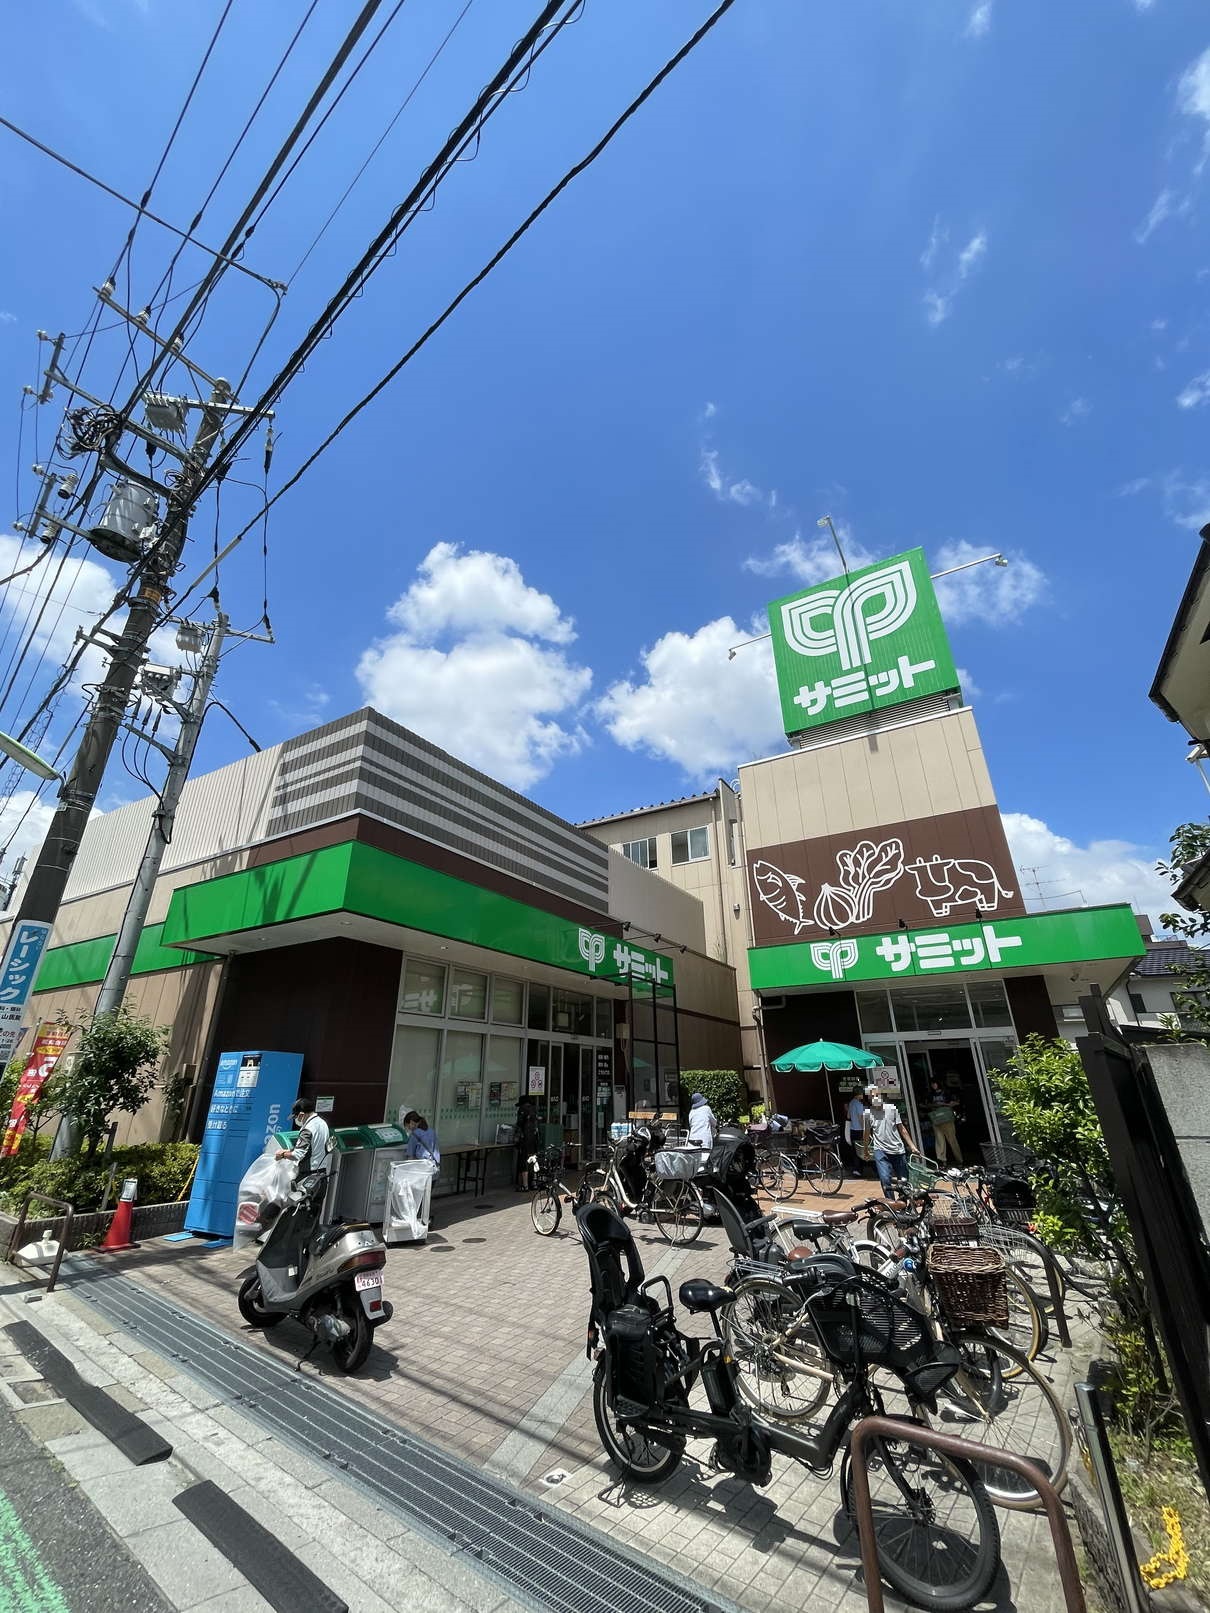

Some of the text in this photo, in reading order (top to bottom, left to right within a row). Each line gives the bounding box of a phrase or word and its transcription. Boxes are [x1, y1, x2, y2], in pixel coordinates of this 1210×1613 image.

[793, 655, 936, 716] サミット
[0, 931, 39, 1001] レーシック
[613, 943, 669, 987] サミット
[876, 926, 1023, 972] サミット
